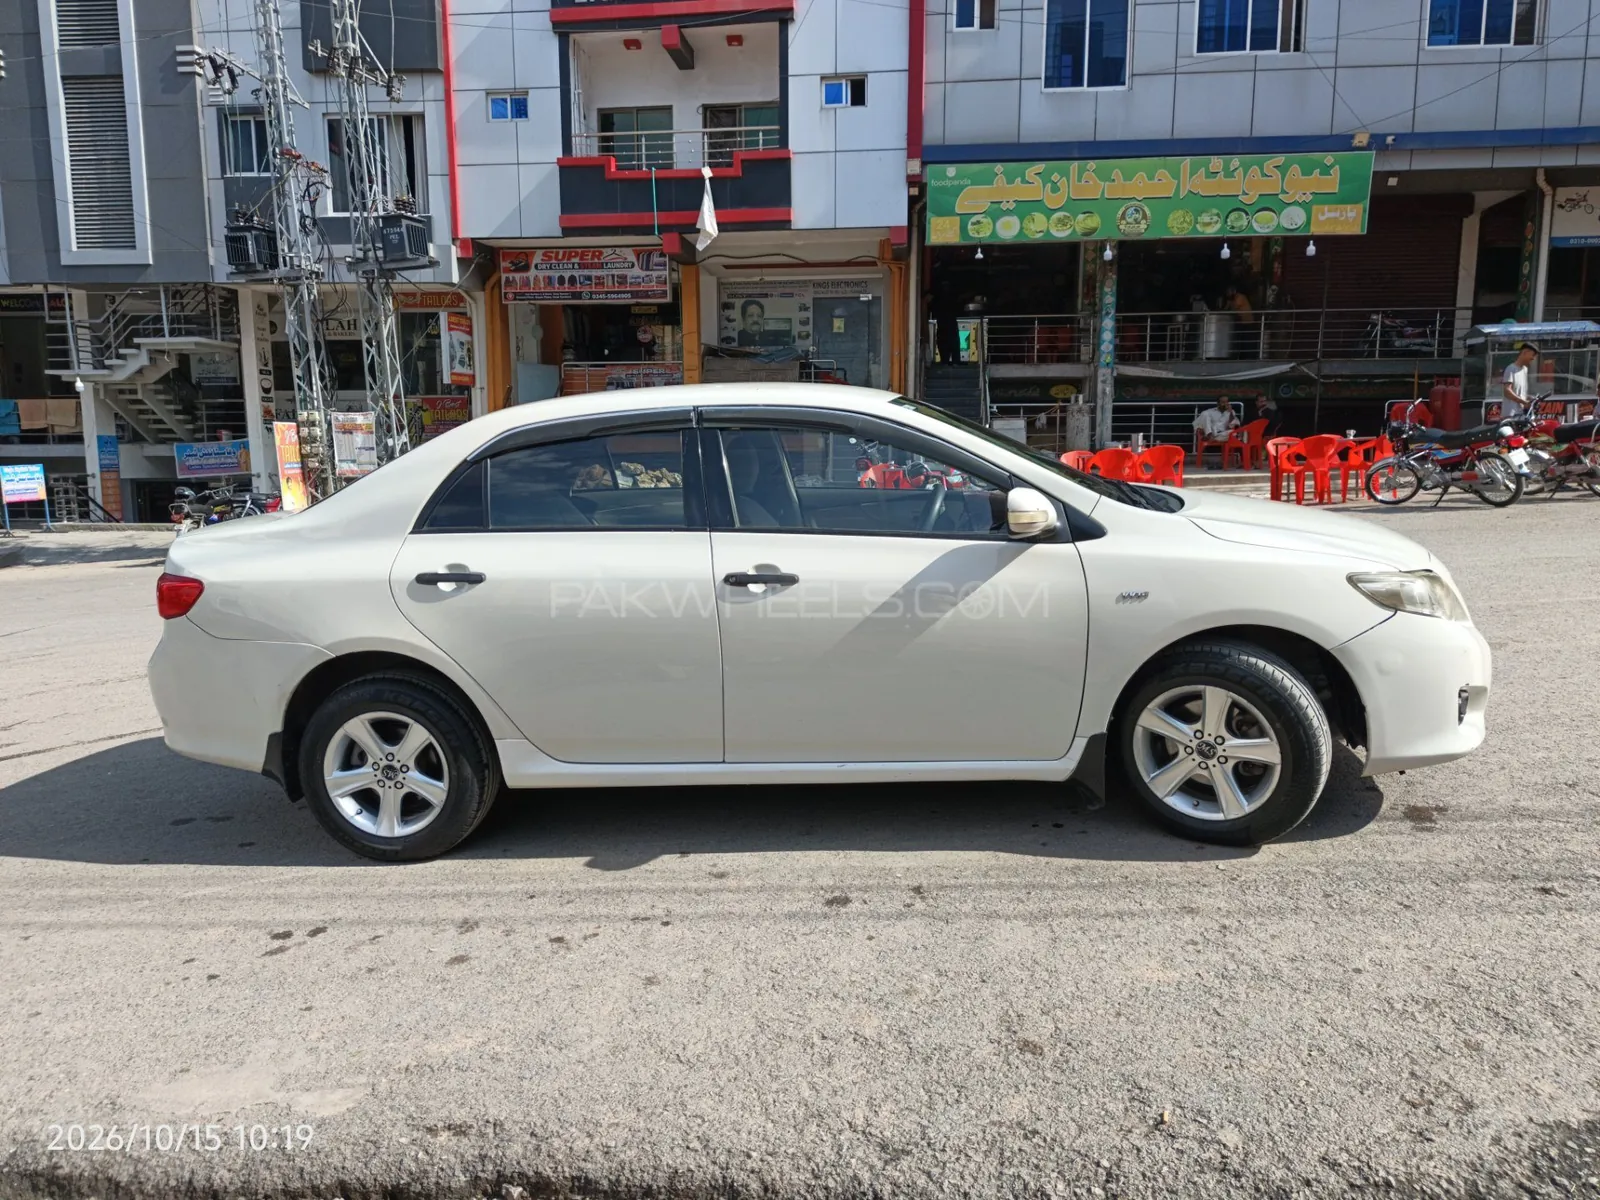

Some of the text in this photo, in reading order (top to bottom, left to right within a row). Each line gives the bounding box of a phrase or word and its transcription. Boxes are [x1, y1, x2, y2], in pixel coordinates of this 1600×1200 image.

[931, 177, 971, 187] foodpanda
[1043, 161, 1105, 210] خان
[1104, 158, 1191, 201] احمد
[954, 163, 1046, 214] کیفے
[541, 250, 604, 262] SUPER
[812, 281, 830, 289] KINGS
[831, 280, 868, 289] ELECTRONICS
[423, 295, 459, 306] TAILORS
[1540, 401, 1564, 413] ZAIN
